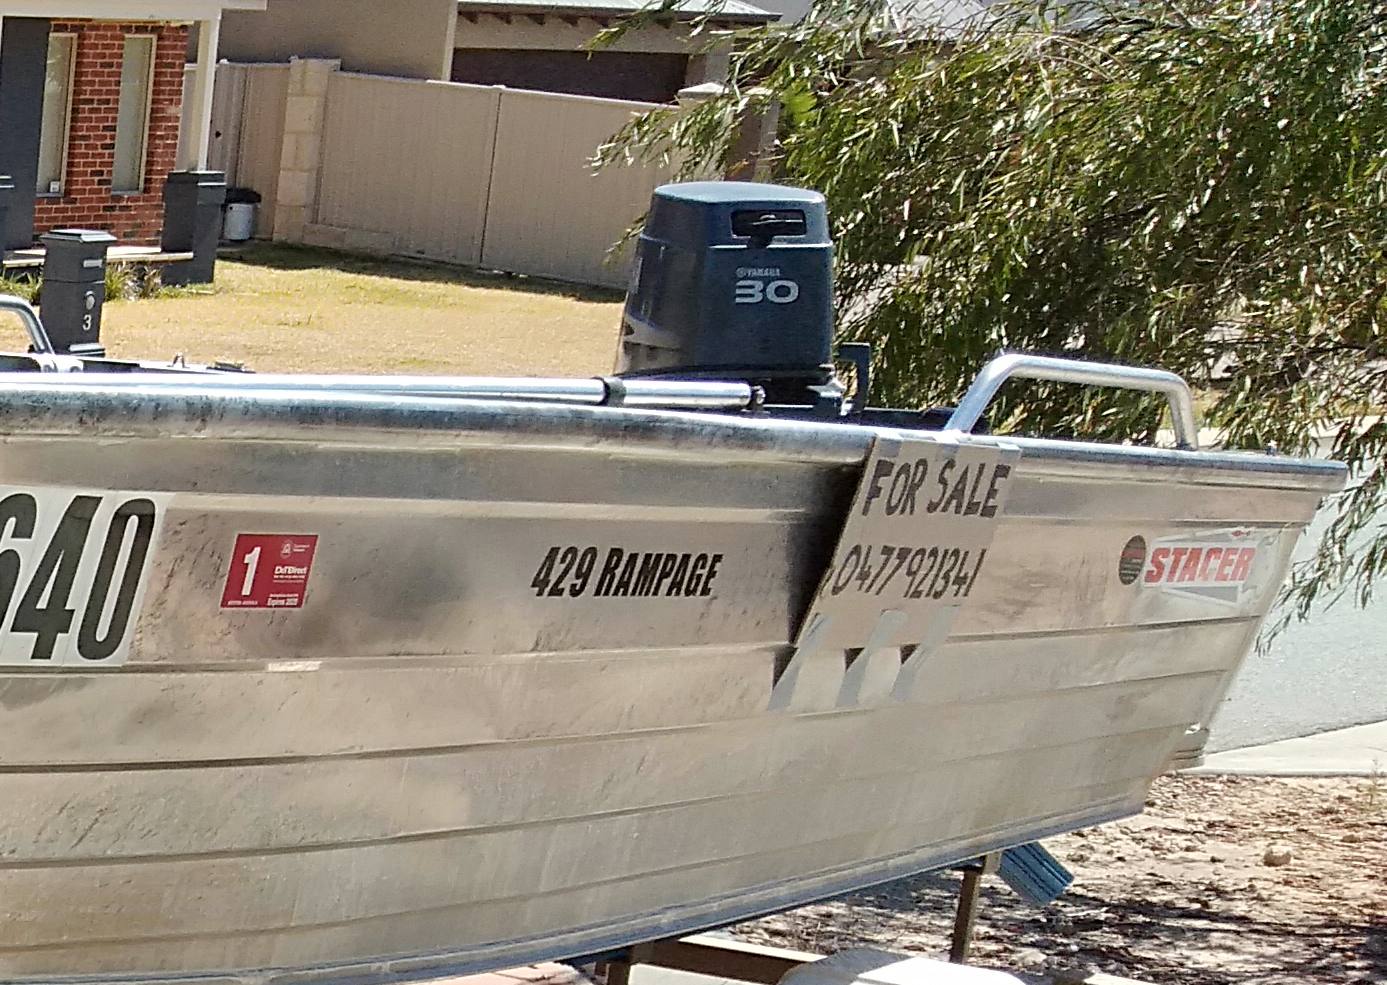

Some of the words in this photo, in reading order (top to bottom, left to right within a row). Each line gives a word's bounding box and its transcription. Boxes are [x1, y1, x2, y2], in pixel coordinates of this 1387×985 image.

[735, 280, 799, 303] 30
[82, 314, 92, 331] 3
[862, 458, 929, 516] FOR
[926, 458, 1011, 518] SALE
[241, 546, 261, 596] 1
[530, 546, 598, 597] 429
[593, 547, 724, 597] RAMPAGE
[831, 544, 987, 599] 0477921341
[1144, 547, 1256, 584] STACER
